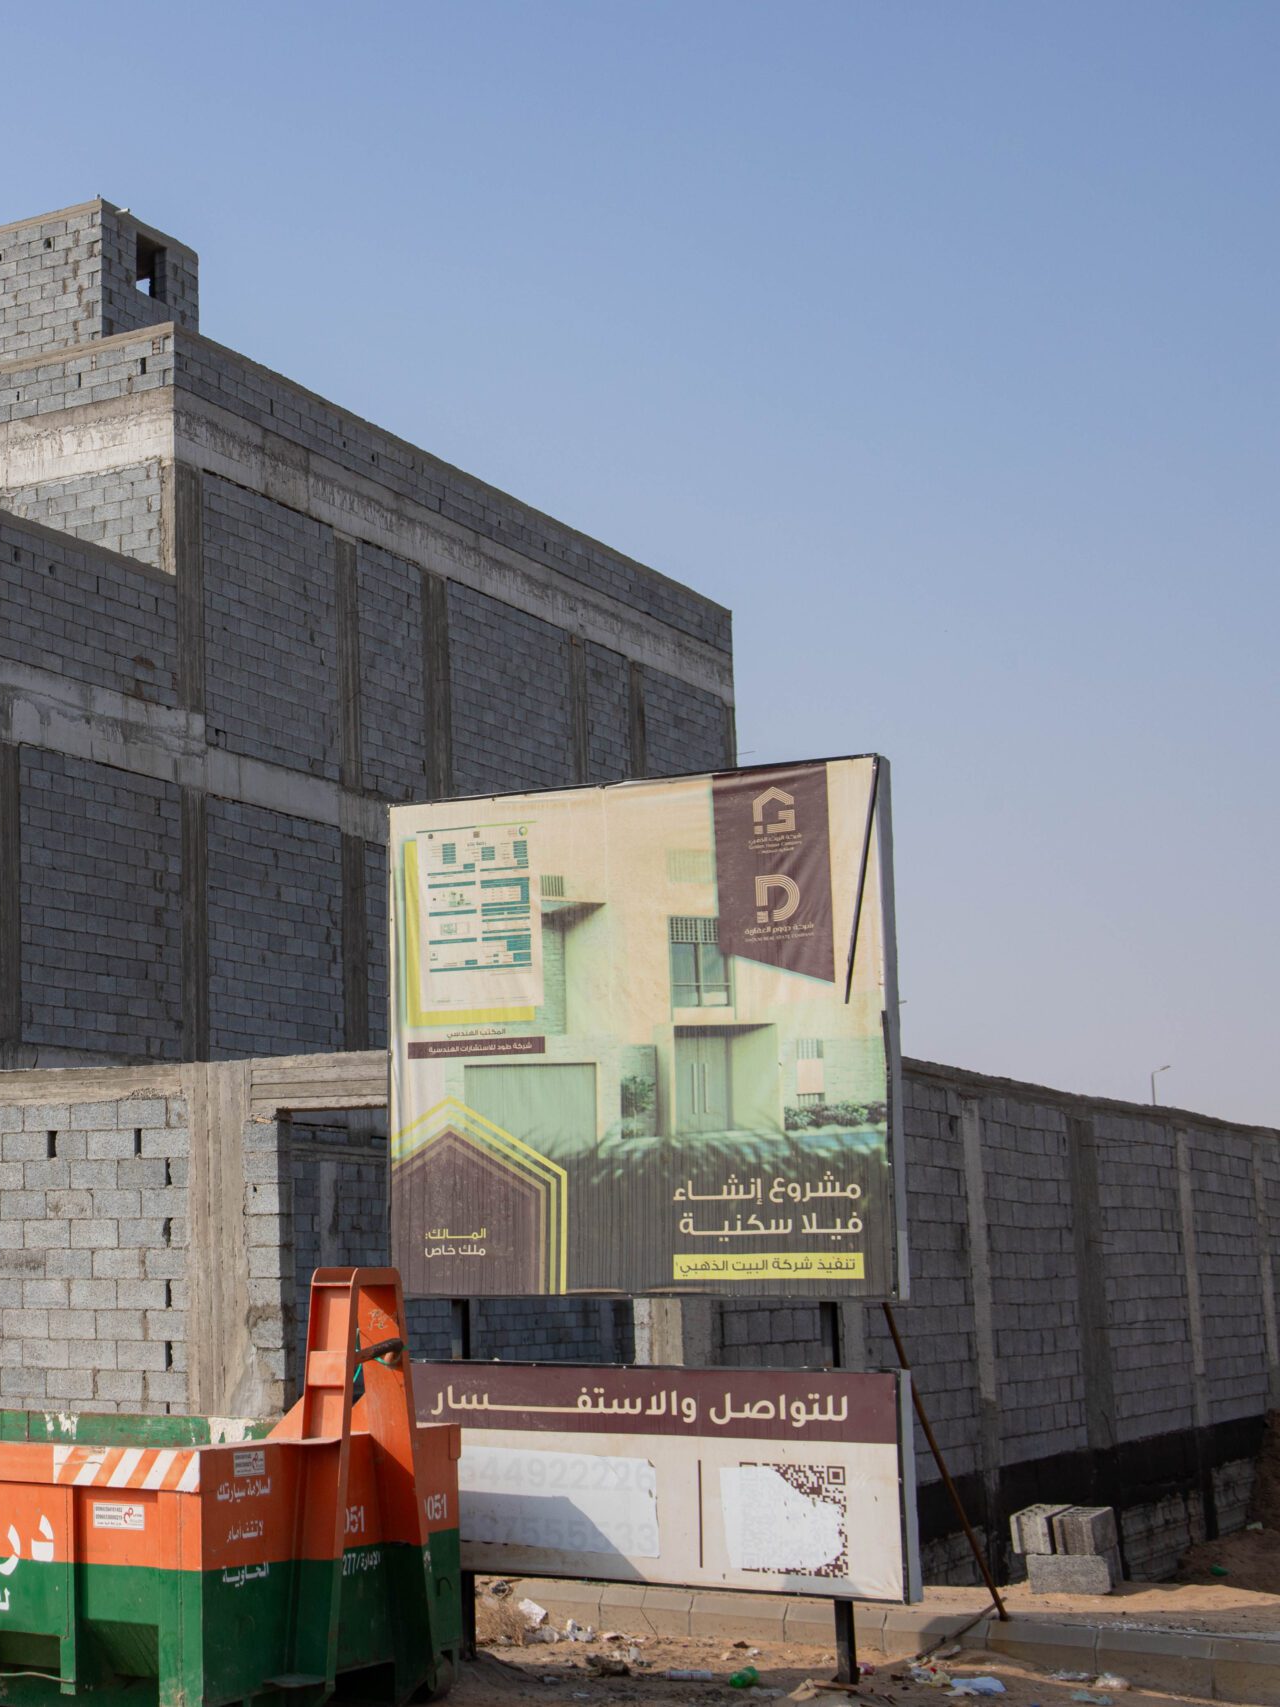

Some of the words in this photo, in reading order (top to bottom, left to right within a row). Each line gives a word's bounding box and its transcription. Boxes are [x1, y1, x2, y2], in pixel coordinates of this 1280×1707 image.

[446, 1028, 479, 1039] الهندسي
[479, 1027, 506, 1036] المكتب
[428, 1045, 460, 1055] الهندسية
[460, 1043, 497, 1053] للاستشارات
[512, 1041, 533, 1050] شركة
[672, 1173, 763, 1205] إنشاء
[769, 1170, 862, 1203] مشروع
[425, 1227, 487, 1239] المالك:
[678, 1212, 793, 1243] سكنية
[801, 1211, 863, 1240] فيلا
[424, 1244, 456, 1258] خاص
[458, 1244, 486, 1256] ملك
[679, 1259, 729, 1277] الذهبي
[731, 1258, 769, 1275] البيت
[771, 1256, 813, 1273] شركة
[816, 1256, 856, 1274] تنفيذ
[430, 1385, 697, 1423] والاستفسار
[709, 1393, 848, 1428] للتواصل
[222, 1560, 270, 1588] الحاوية
